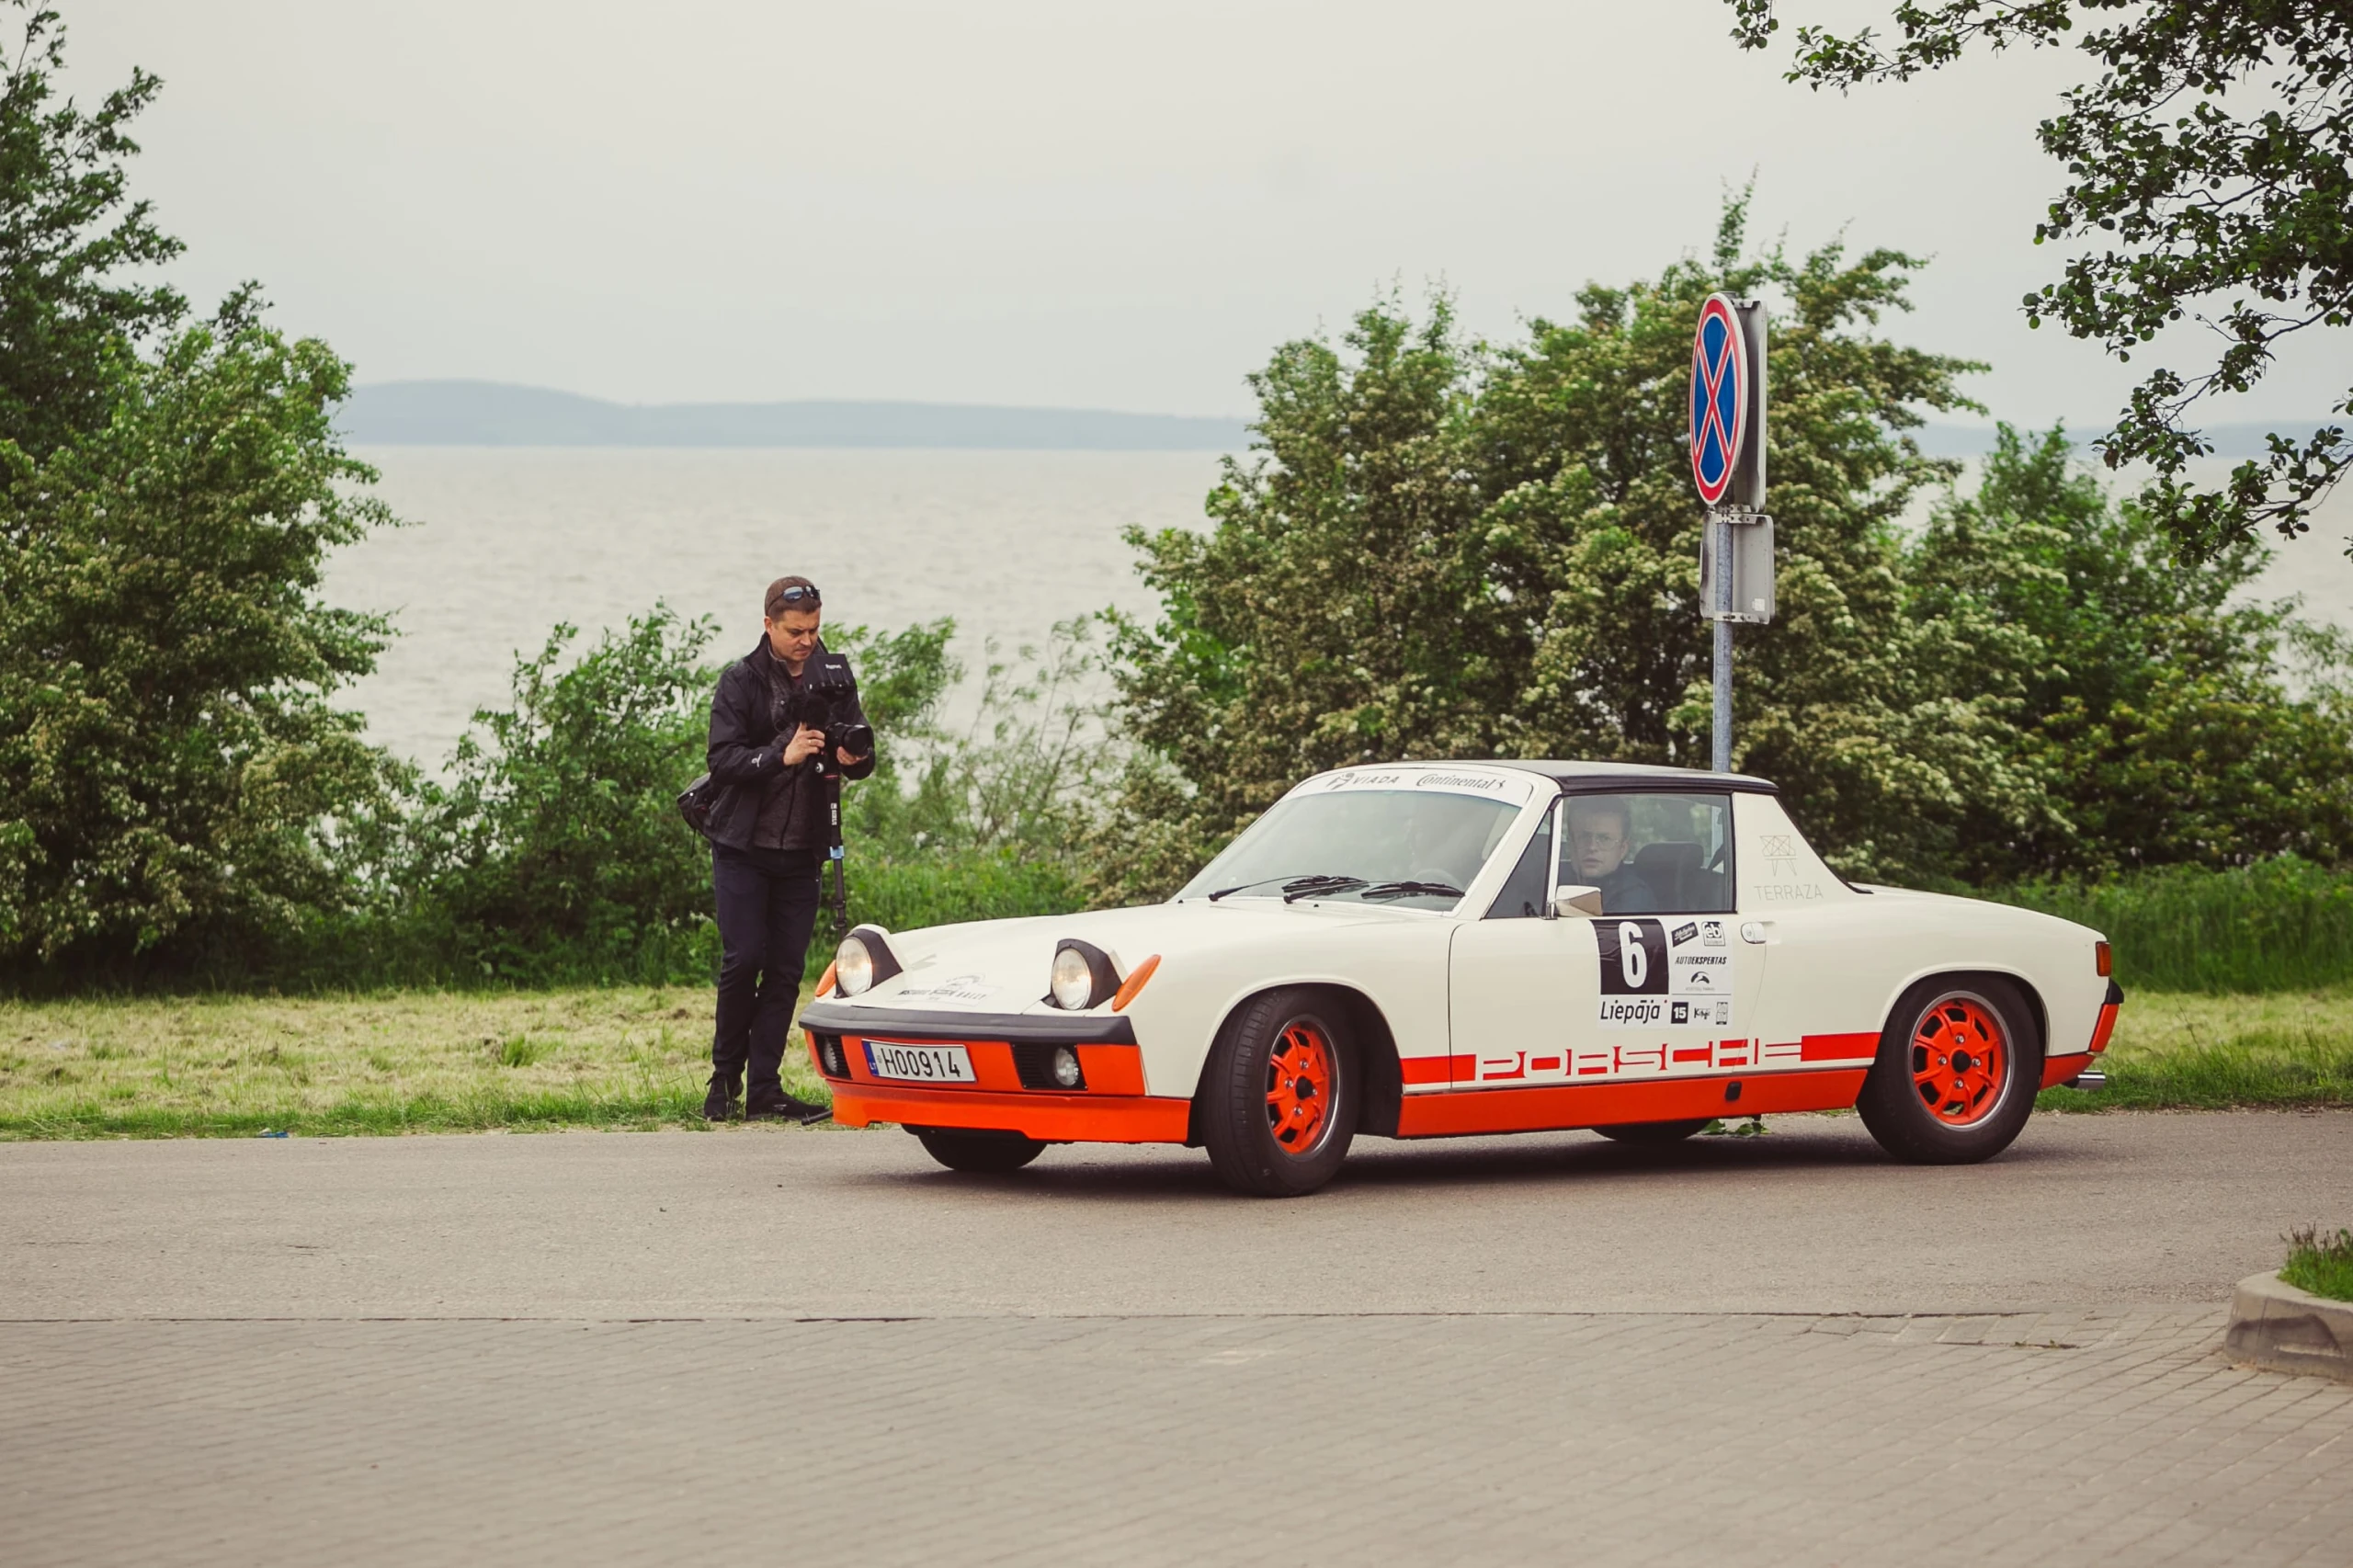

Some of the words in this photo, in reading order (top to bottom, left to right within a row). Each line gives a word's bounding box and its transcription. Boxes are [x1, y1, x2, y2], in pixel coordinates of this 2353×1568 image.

[1416, 773, 1496, 790] Continental
[1754, 883, 1824, 901] TERRAZA
[1619, 921, 1648, 988] 6
[1675, 956, 1727, 965] AUTOEKSPERTAS
[1600, 999, 1660, 1024] Liepāja
[1673, 1006, 1688, 1019] 15
[881, 1048, 961, 1077] H00914
[1475, 1036, 1802, 1083] PORSCHE
